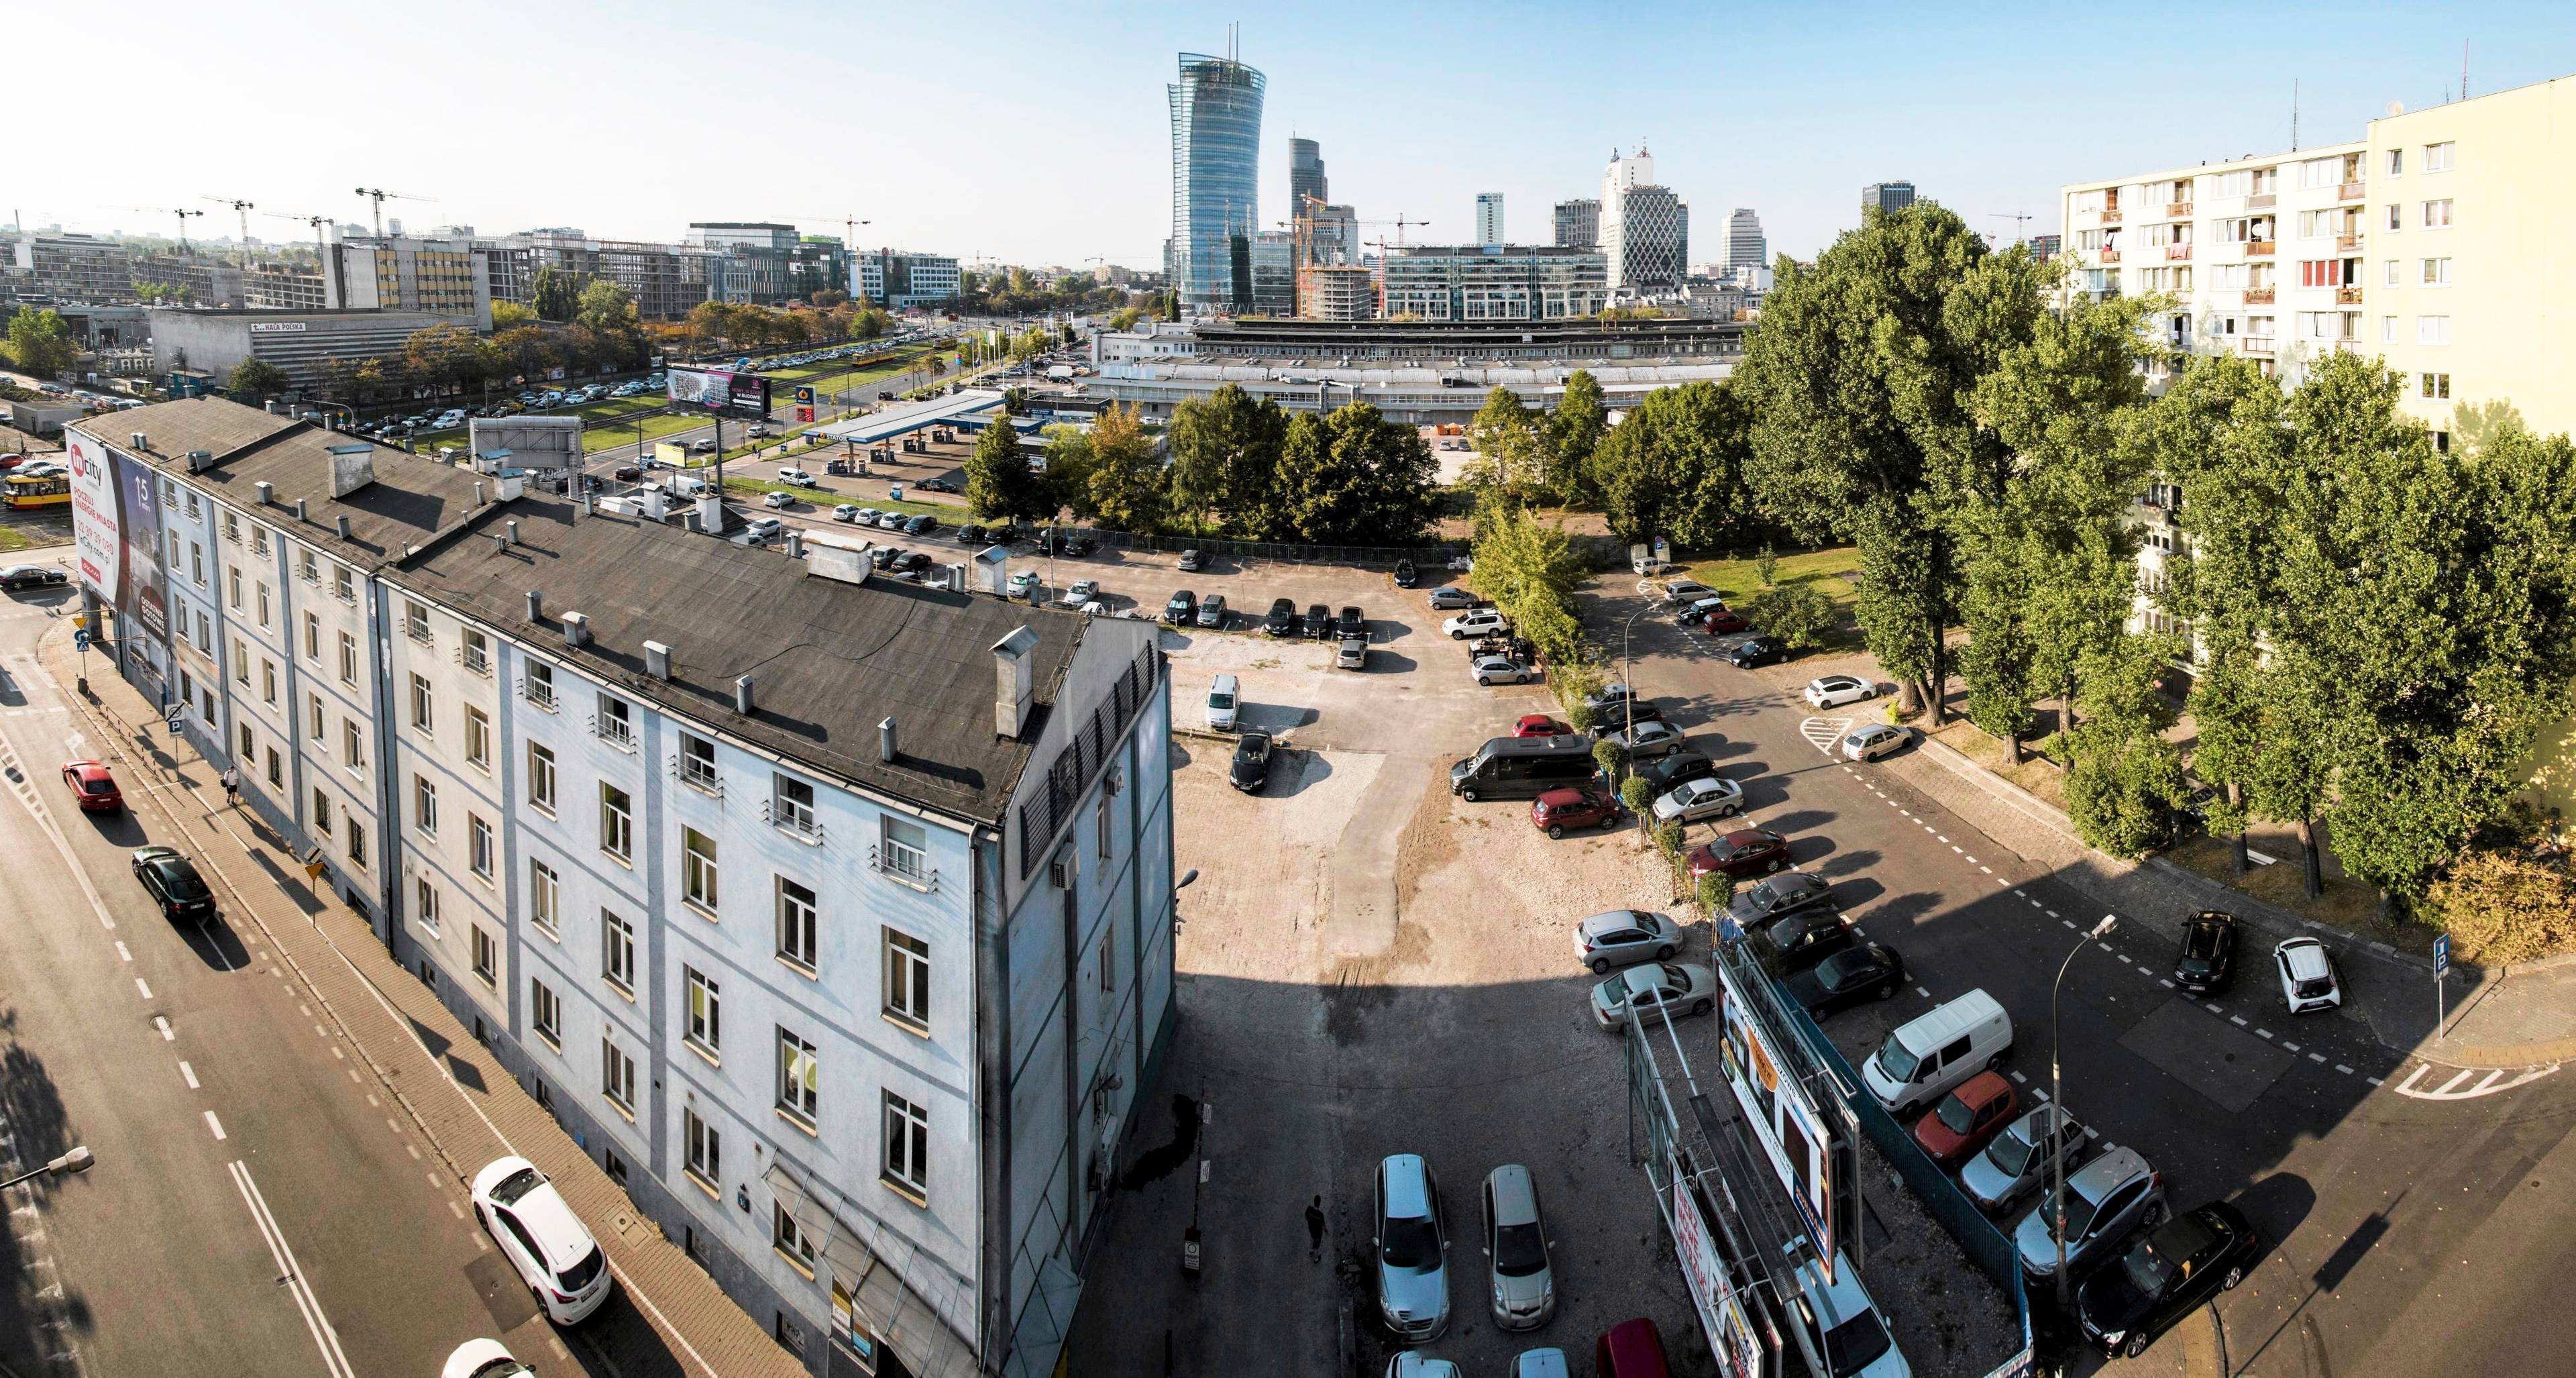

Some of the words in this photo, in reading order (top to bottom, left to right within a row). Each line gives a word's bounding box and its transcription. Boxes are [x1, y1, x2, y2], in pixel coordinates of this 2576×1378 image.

[74, 486, 93, 506] POCZUJ
[142, 502, 150, 513] min
[77, 520, 85, 534] 22
[96, 512, 117, 533] MIASTA
[141, 596, 164, 619] OSTATNIE
[142, 605, 165, 629] GOTOWE
[143, 614, 166, 637] MIESZKANIA
[172, 721, 180, 731] P
[2438, 954, 2447, 970] P
